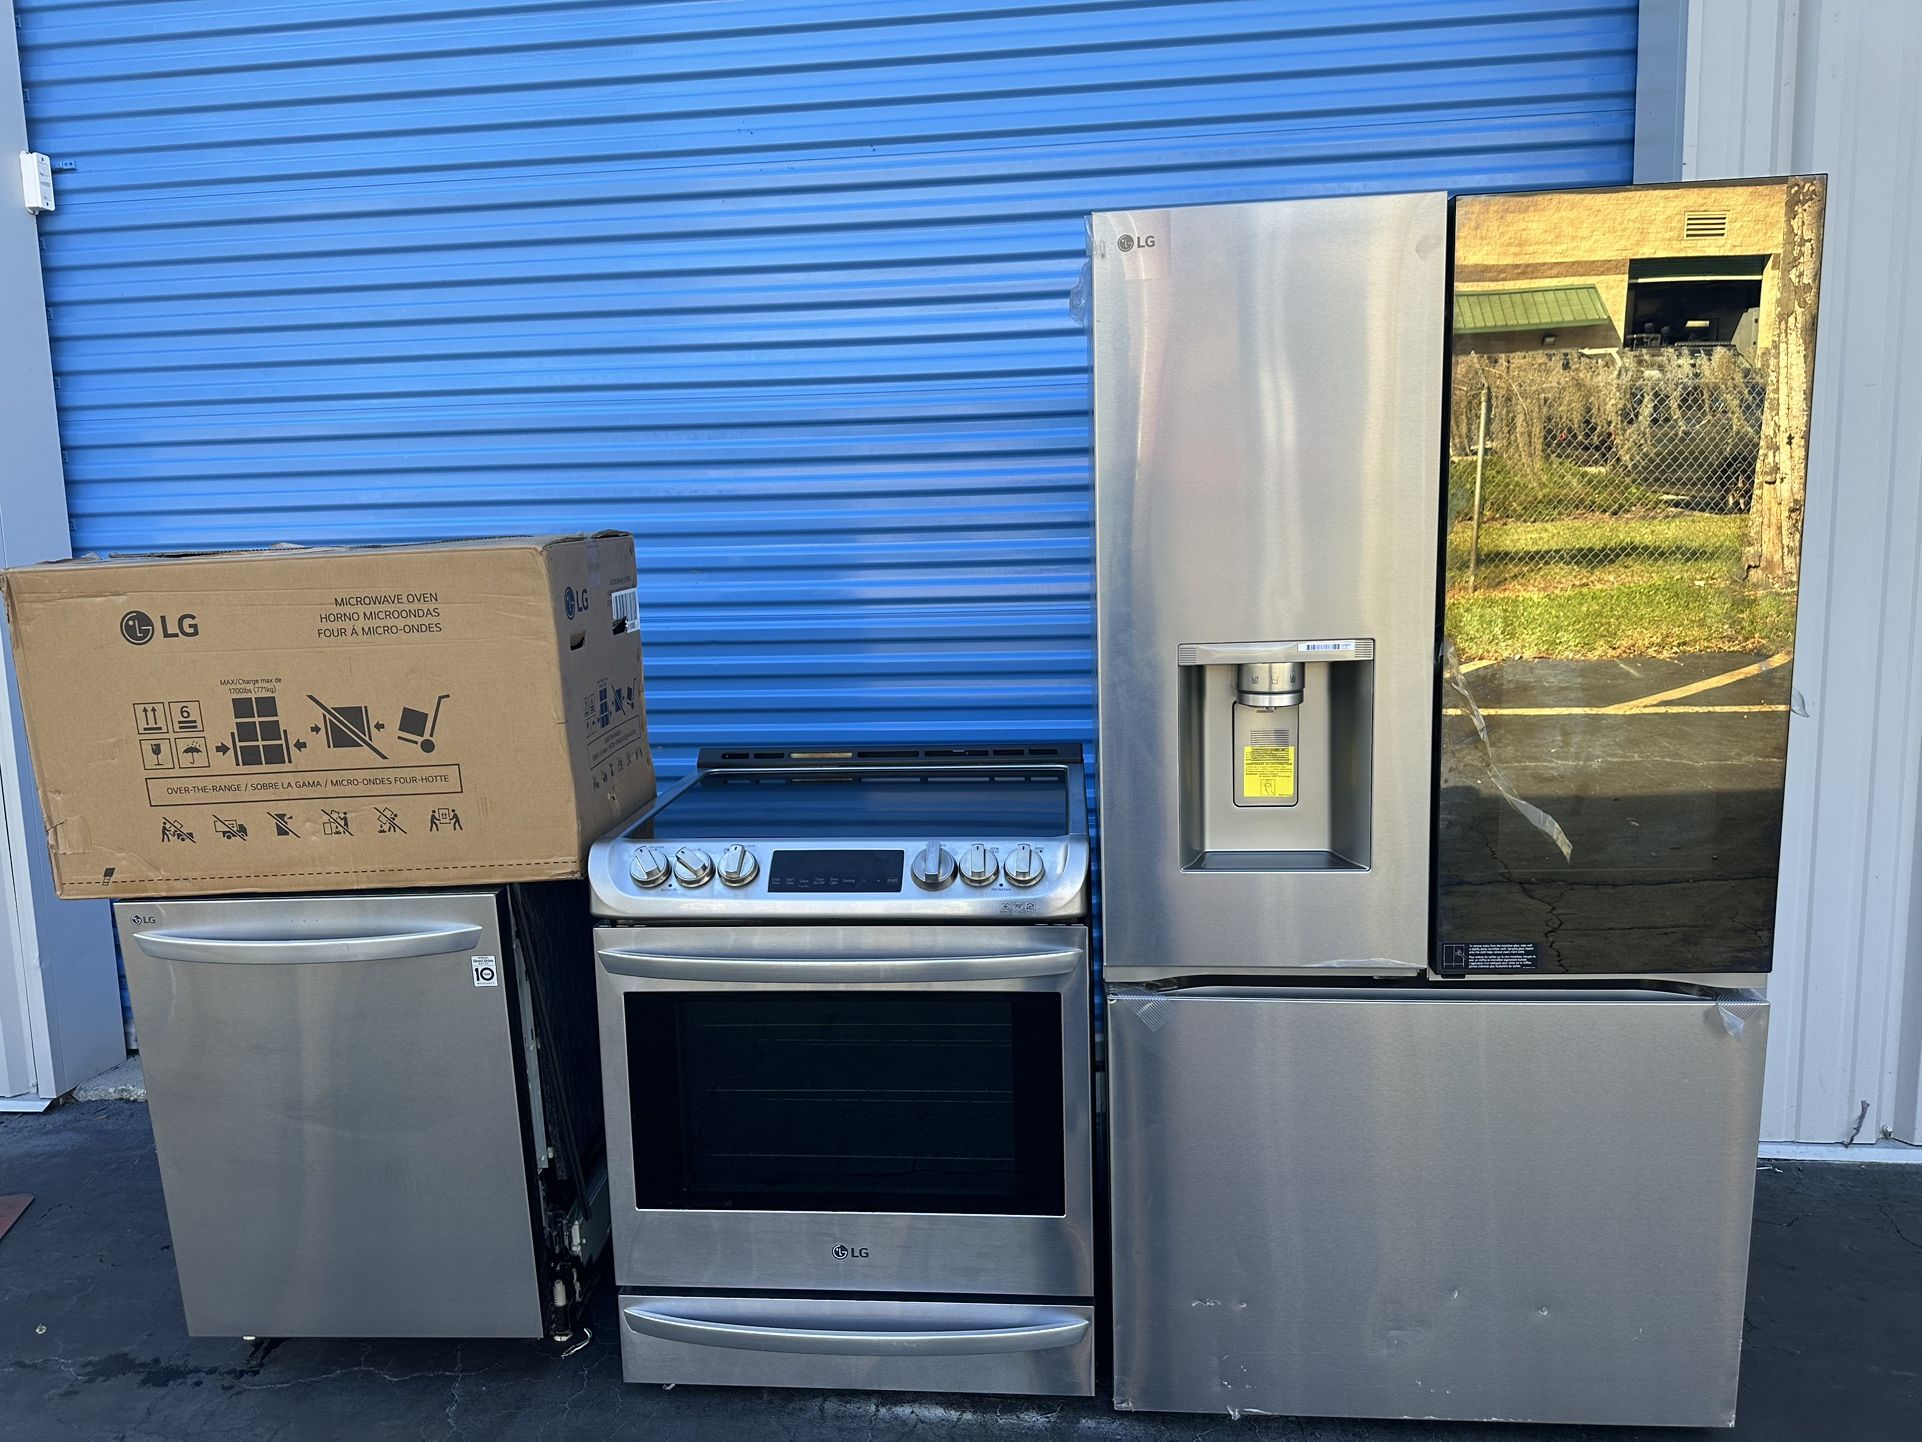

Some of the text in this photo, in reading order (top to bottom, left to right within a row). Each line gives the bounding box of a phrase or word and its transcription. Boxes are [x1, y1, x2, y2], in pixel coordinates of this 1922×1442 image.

[1137, 235, 1155, 248] LG
[334, 592, 438, 607] MICROWAVE OVEN
[576, 588, 588, 612] LG
[320, 607, 440, 623] HORNO MICROONDAS
[160, 613, 199, 638] LG
[317, 627, 347, 638] FOUR
[361, 622, 442, 636] MICRO-ONDES
[180, 705, 190, 719] 6
[167, 783, 242, 795] OVER-THE-RANGE
[250, 782, 279, 791] SOBRE
[281, 781, 293, 789] LA
[295, 780, 322, 789] GAMA
[331, 777, 392, 788] MICRO-ONDES
[394, 774, 449, 785] FOUR-HOTTE
[143, 916, 156, 924] LG
[851, 1247, 869, 1258] LG
